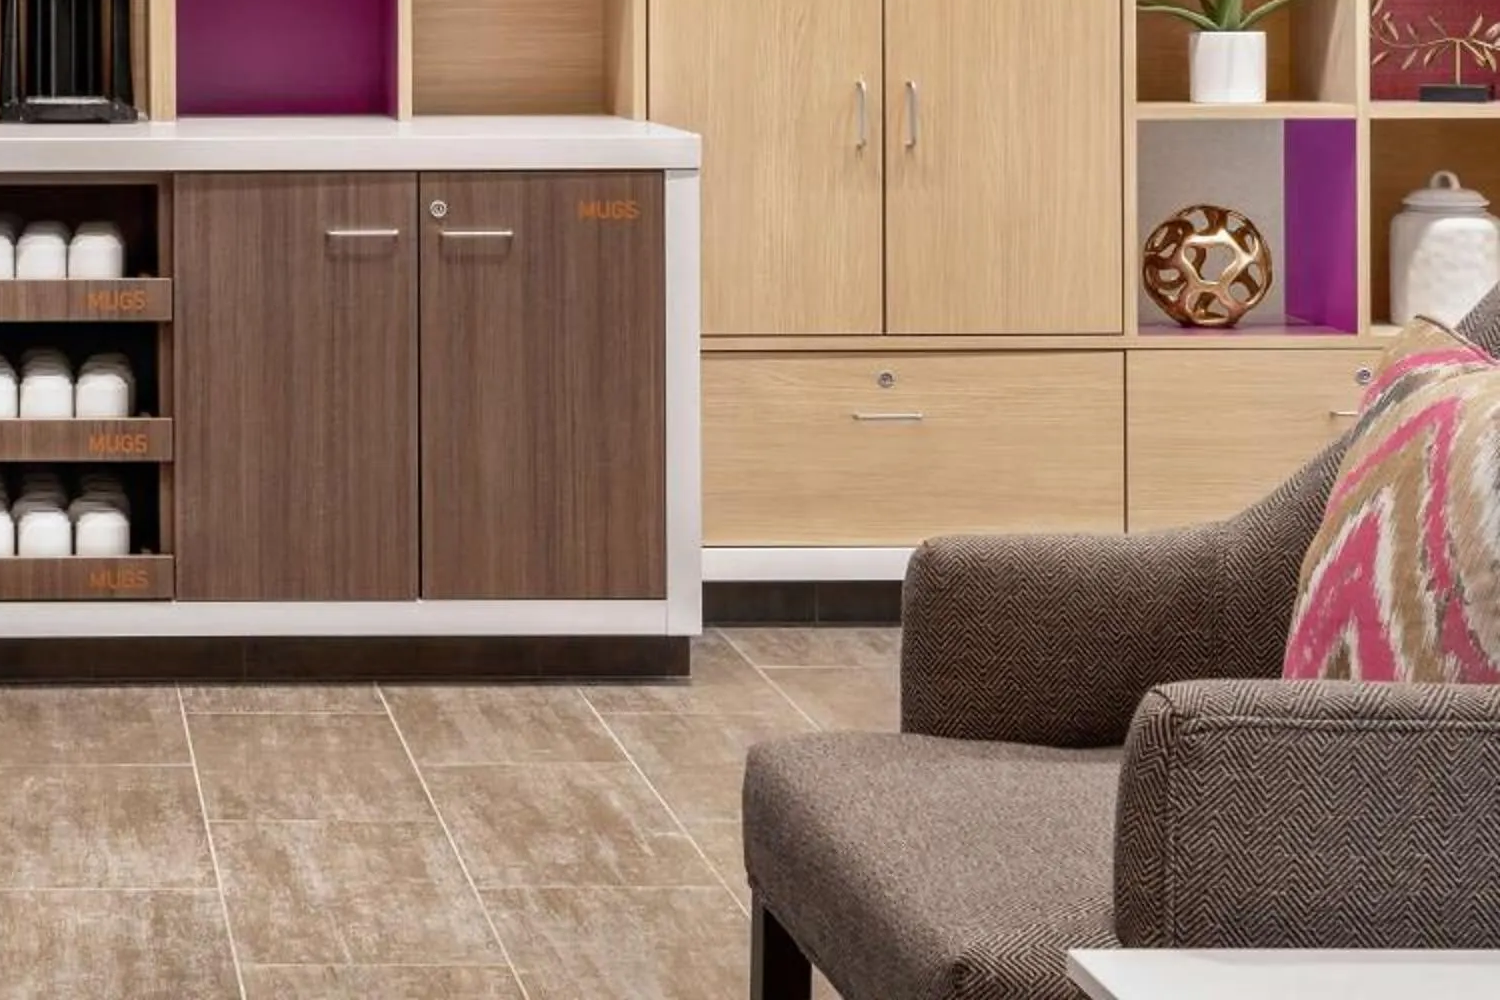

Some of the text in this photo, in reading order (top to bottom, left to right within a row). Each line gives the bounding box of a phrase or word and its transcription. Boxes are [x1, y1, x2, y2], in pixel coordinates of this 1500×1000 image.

[578, 200, 640, 220] MUGS
[87, 290, 146, 311] MUGS
[88, 433, 148, 454] MUGS
